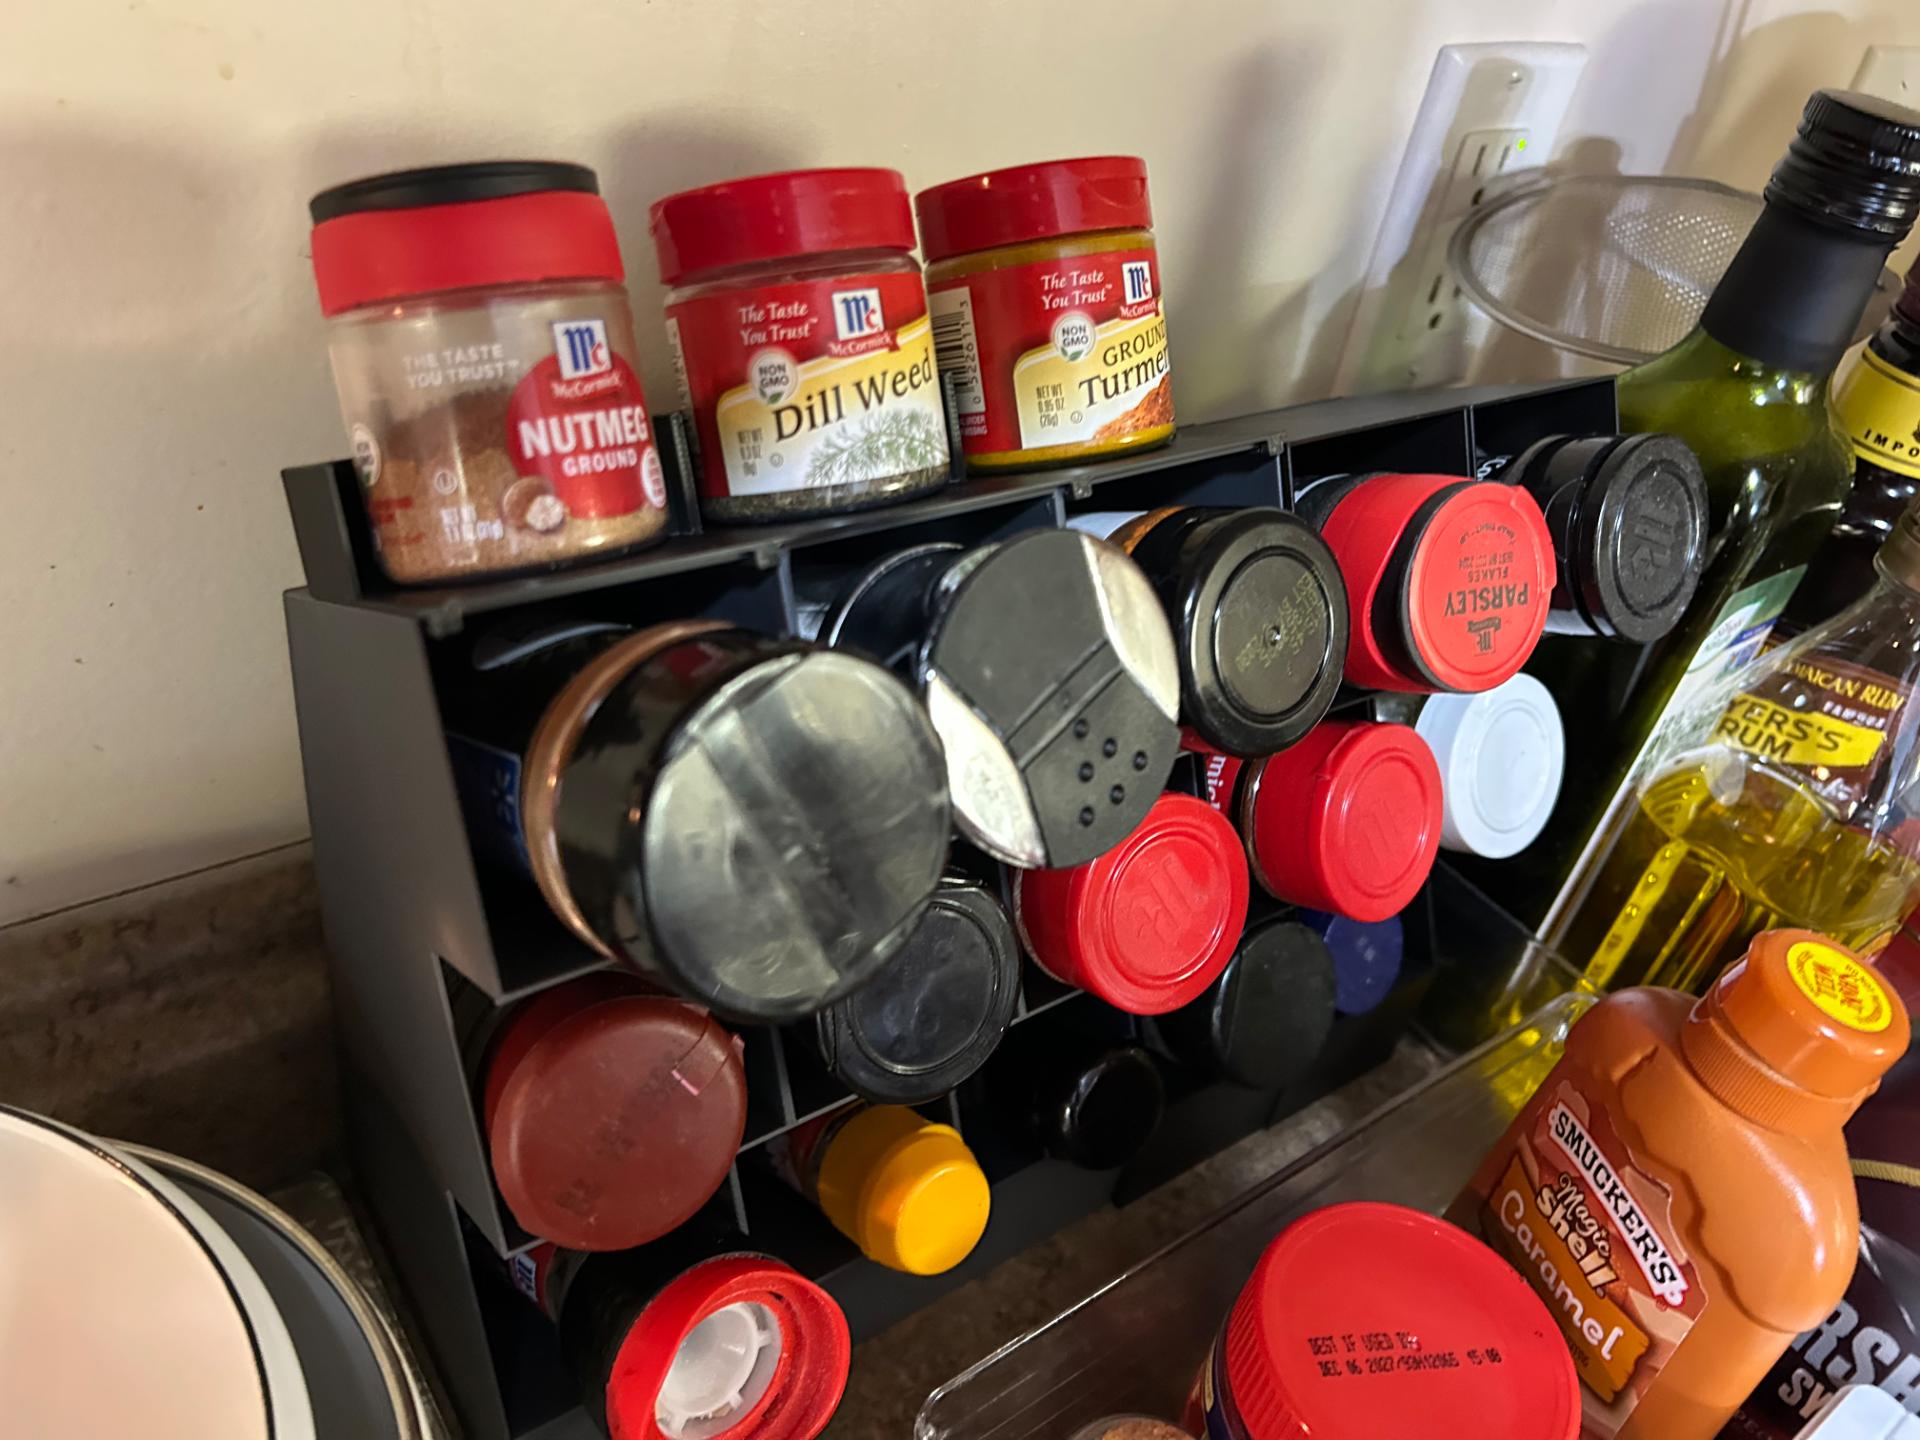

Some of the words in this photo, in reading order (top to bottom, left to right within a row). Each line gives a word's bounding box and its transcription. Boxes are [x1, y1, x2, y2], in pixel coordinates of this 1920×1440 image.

[1040, 274, 1067, 291] The
[1068, 270, 1104, 287] Taste
[738, 304, 767, 325] The
[769, 301, 809, 319] Taste
[1041, 294, 1069, 311] You
[740, 327, 768, 347] You
[827, 331, 893, 358] McCormick
[1061, 324, 1087, 338] NON
[1062, 334, 1089, 347] GMO
[403, 351, 439, 371] THE
[445, 344, 504, 365] TASTE
[757, 362, 787, 377] NON
[405, 367, 443, 389] YOU
[759, 373, 789, 388] GMO
[1079, 344, 1169, 408] Turmer
[771, 384, 847, 444] Dill
[851, 346, 934, 412] Weed
[521, 406, 648, 459] NUTMEG
[1863, 428, 1920, 458] IMPO
[562, 446, 638, 476] GROUND
[1467, 566, 1509, 583] FLAKES
[1443, 582, 1529, 617] PARSLEY
[1718, 715, 1794, 761] RUM
[1727, 697, 1841, 753] YERS'S
[1553, 1109, 1679, 1286] SMUCKER'S
[1556, 1171, 1612, 1258] Magic
[1535, 1183, 1620, 1290] Shell
[1500, 1188, 1625, 1361] Caramel
[1308, 1335, 1338, 1356] BEST
[1361, 1332, 1394, 1351] USED
